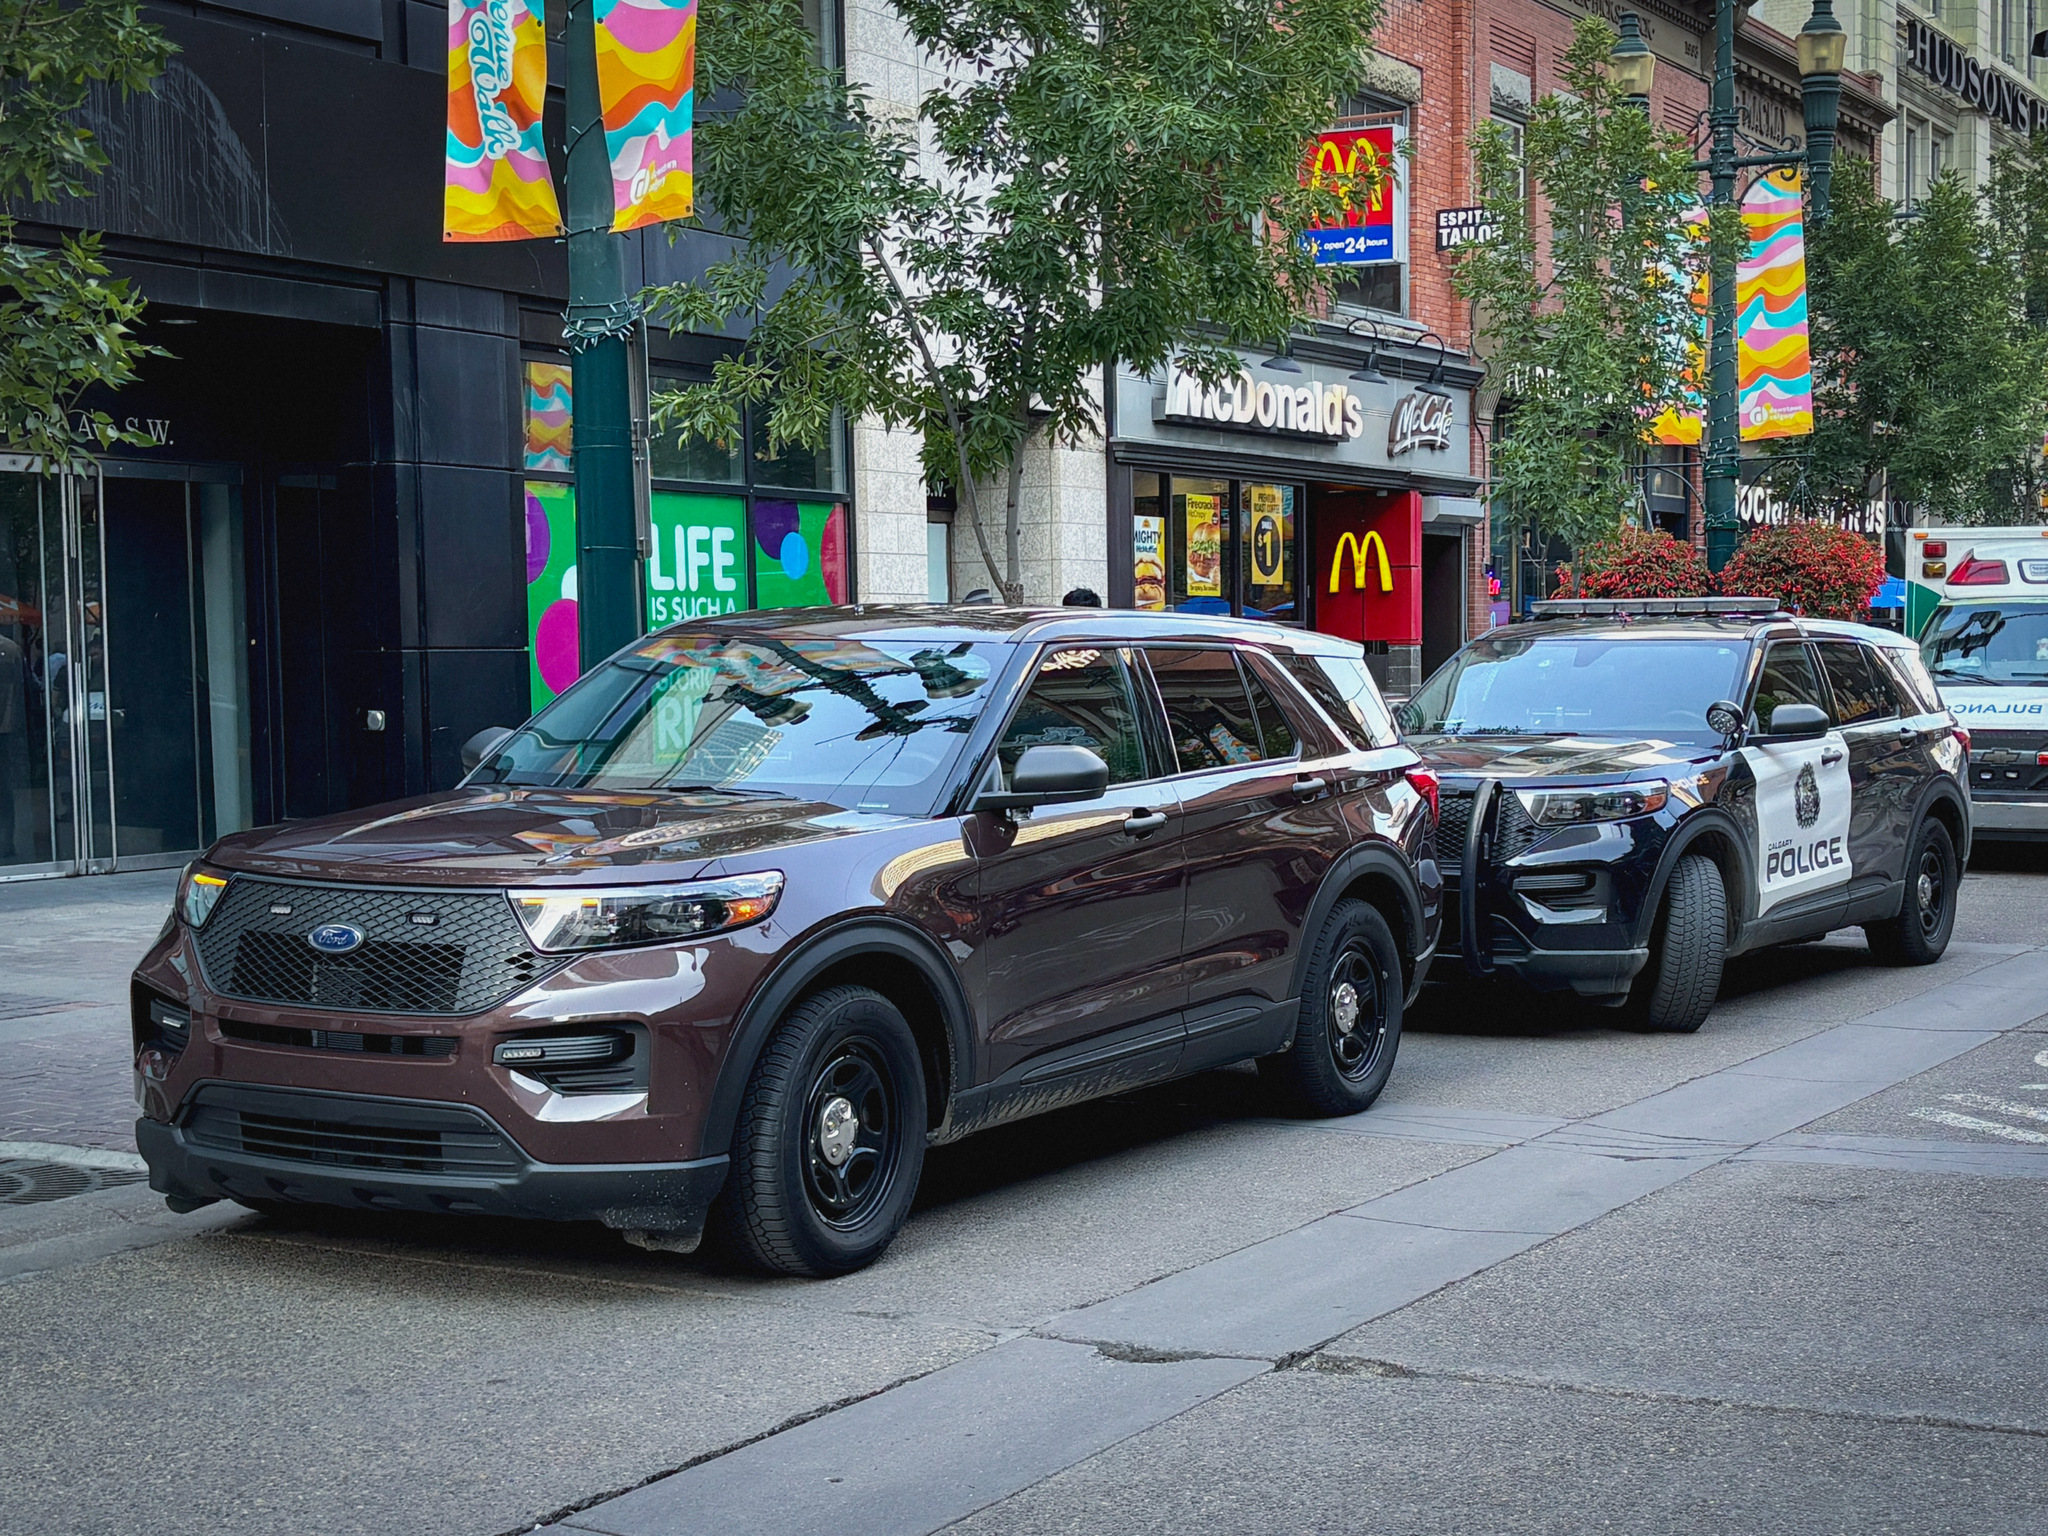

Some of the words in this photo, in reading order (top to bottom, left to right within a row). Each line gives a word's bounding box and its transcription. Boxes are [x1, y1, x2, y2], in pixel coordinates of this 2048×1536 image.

[489, 0, 513, 82] enue
[1914, 21, 2030, 137] HUDSON'S
[1440, 209, 1506, 226] ESPITA
[1323, 241, 1345, 251] open
[1344, 236, 1366, 253] 24
[1366, 238, 1388, 247] hours
[1165, 358, 1363, 438] McDonald's
[650, 523, 737, 591] LIFE
[652, 597, 667, 621] IS
[671, 597, 720, 621] SUCH
[726, 597, 736, 613] A
[1766, 836, 1843, 883] POLICE
[1768, 839, 1793, 851] CALGARY
[318, 929, 348, 945] Ford
